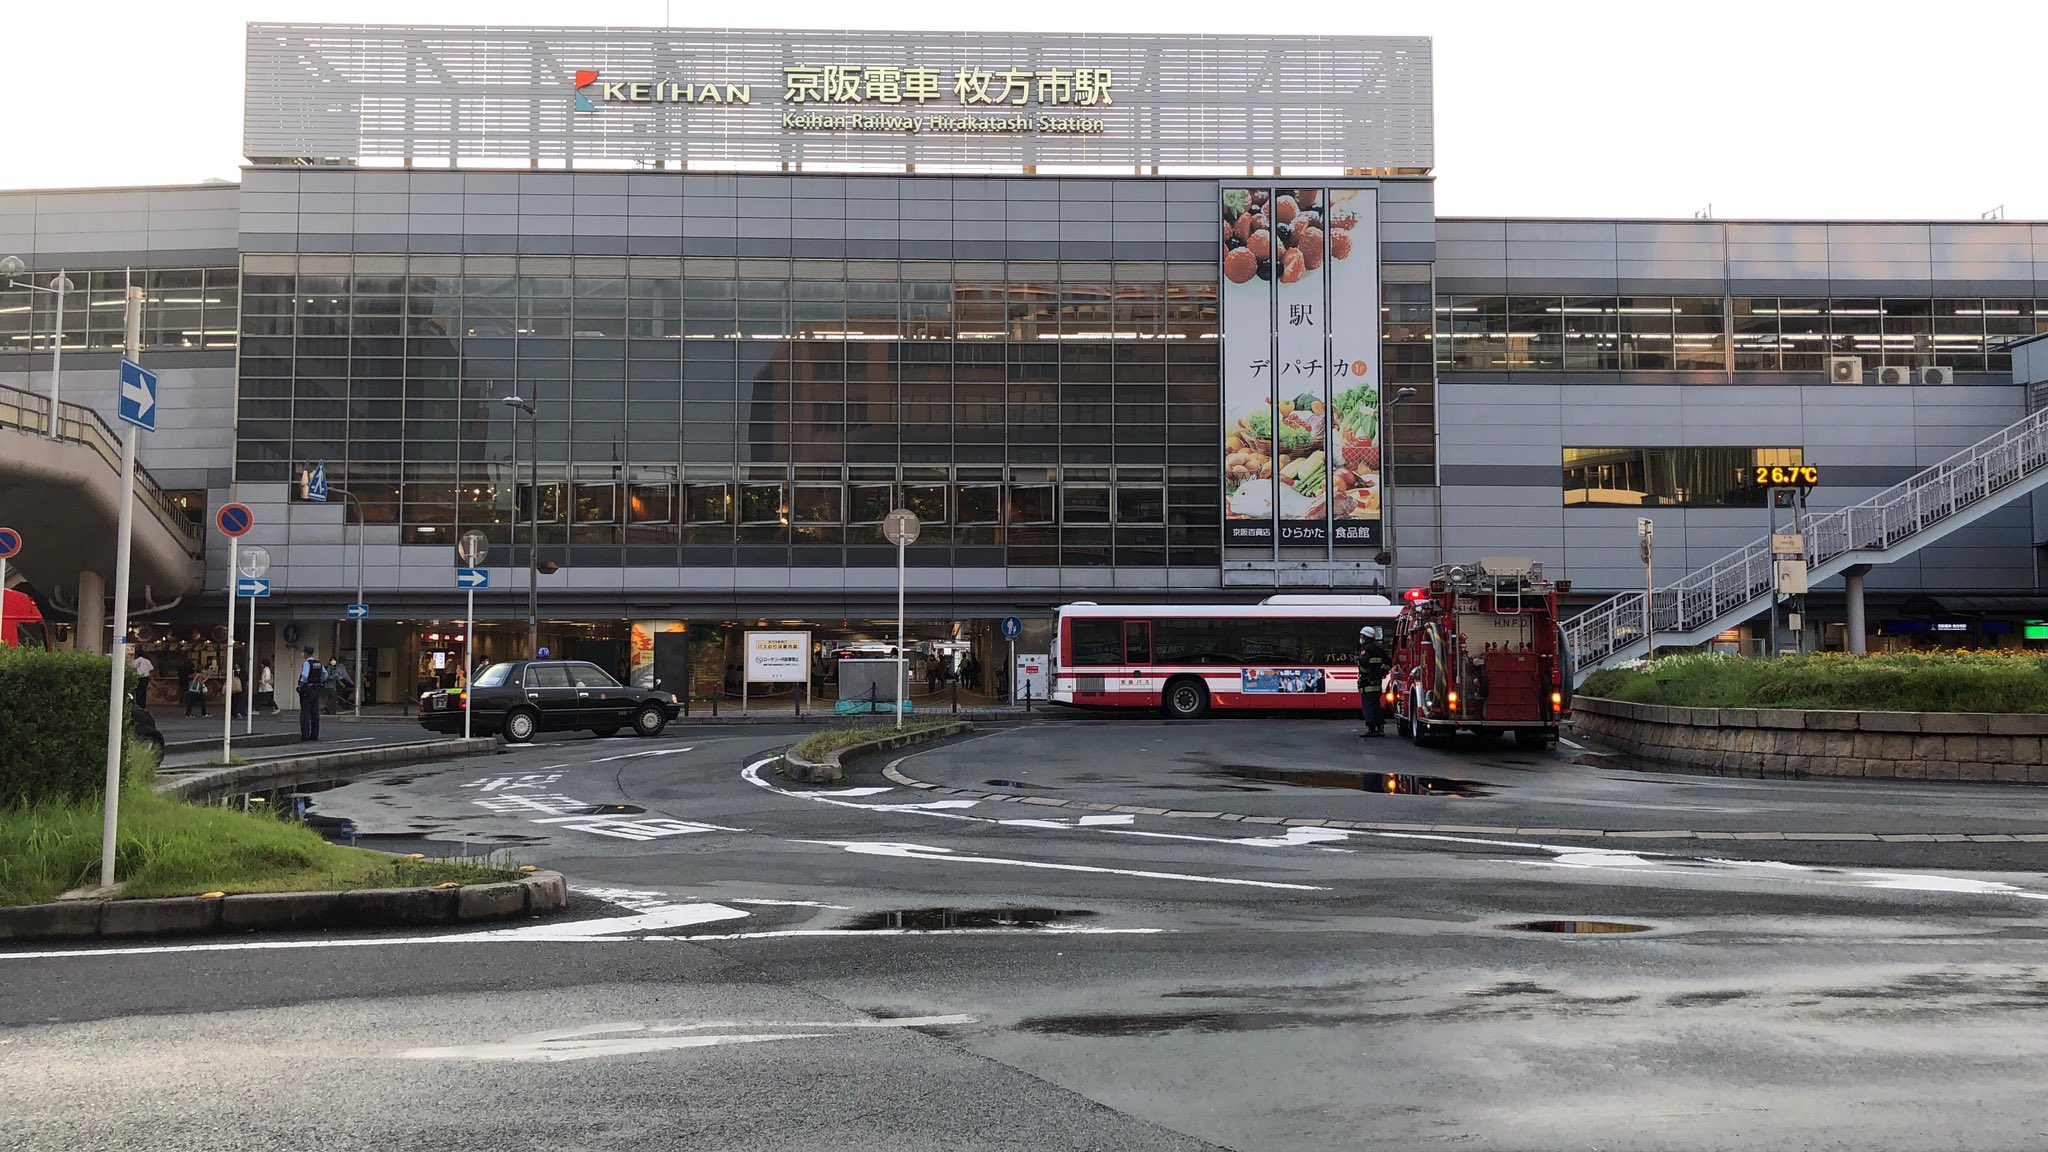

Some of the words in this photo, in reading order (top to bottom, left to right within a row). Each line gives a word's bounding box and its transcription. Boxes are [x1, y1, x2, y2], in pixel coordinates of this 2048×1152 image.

[603, 79, 751, 103] KEIHAN
[783, 64, 941, 104] 京阪電車
[953, 66, 1113, 105] 枚方市駅
[782, 112, 846, 128] Keihan
[852, 112, 923, 133] Railway
[930, 114, 1033, 130] Hirakatashi
[1039, 115, 1104, 131] Station
[1289, 304, 1314, 326] 駅
[1249, 358, 1349, 378] デパチカ
[1232, 528, 1271, 537] 京阪百貨店
[1282, 527, 1325, 539] ひらかた
[1335, 527, 1370, 539] 食品館
